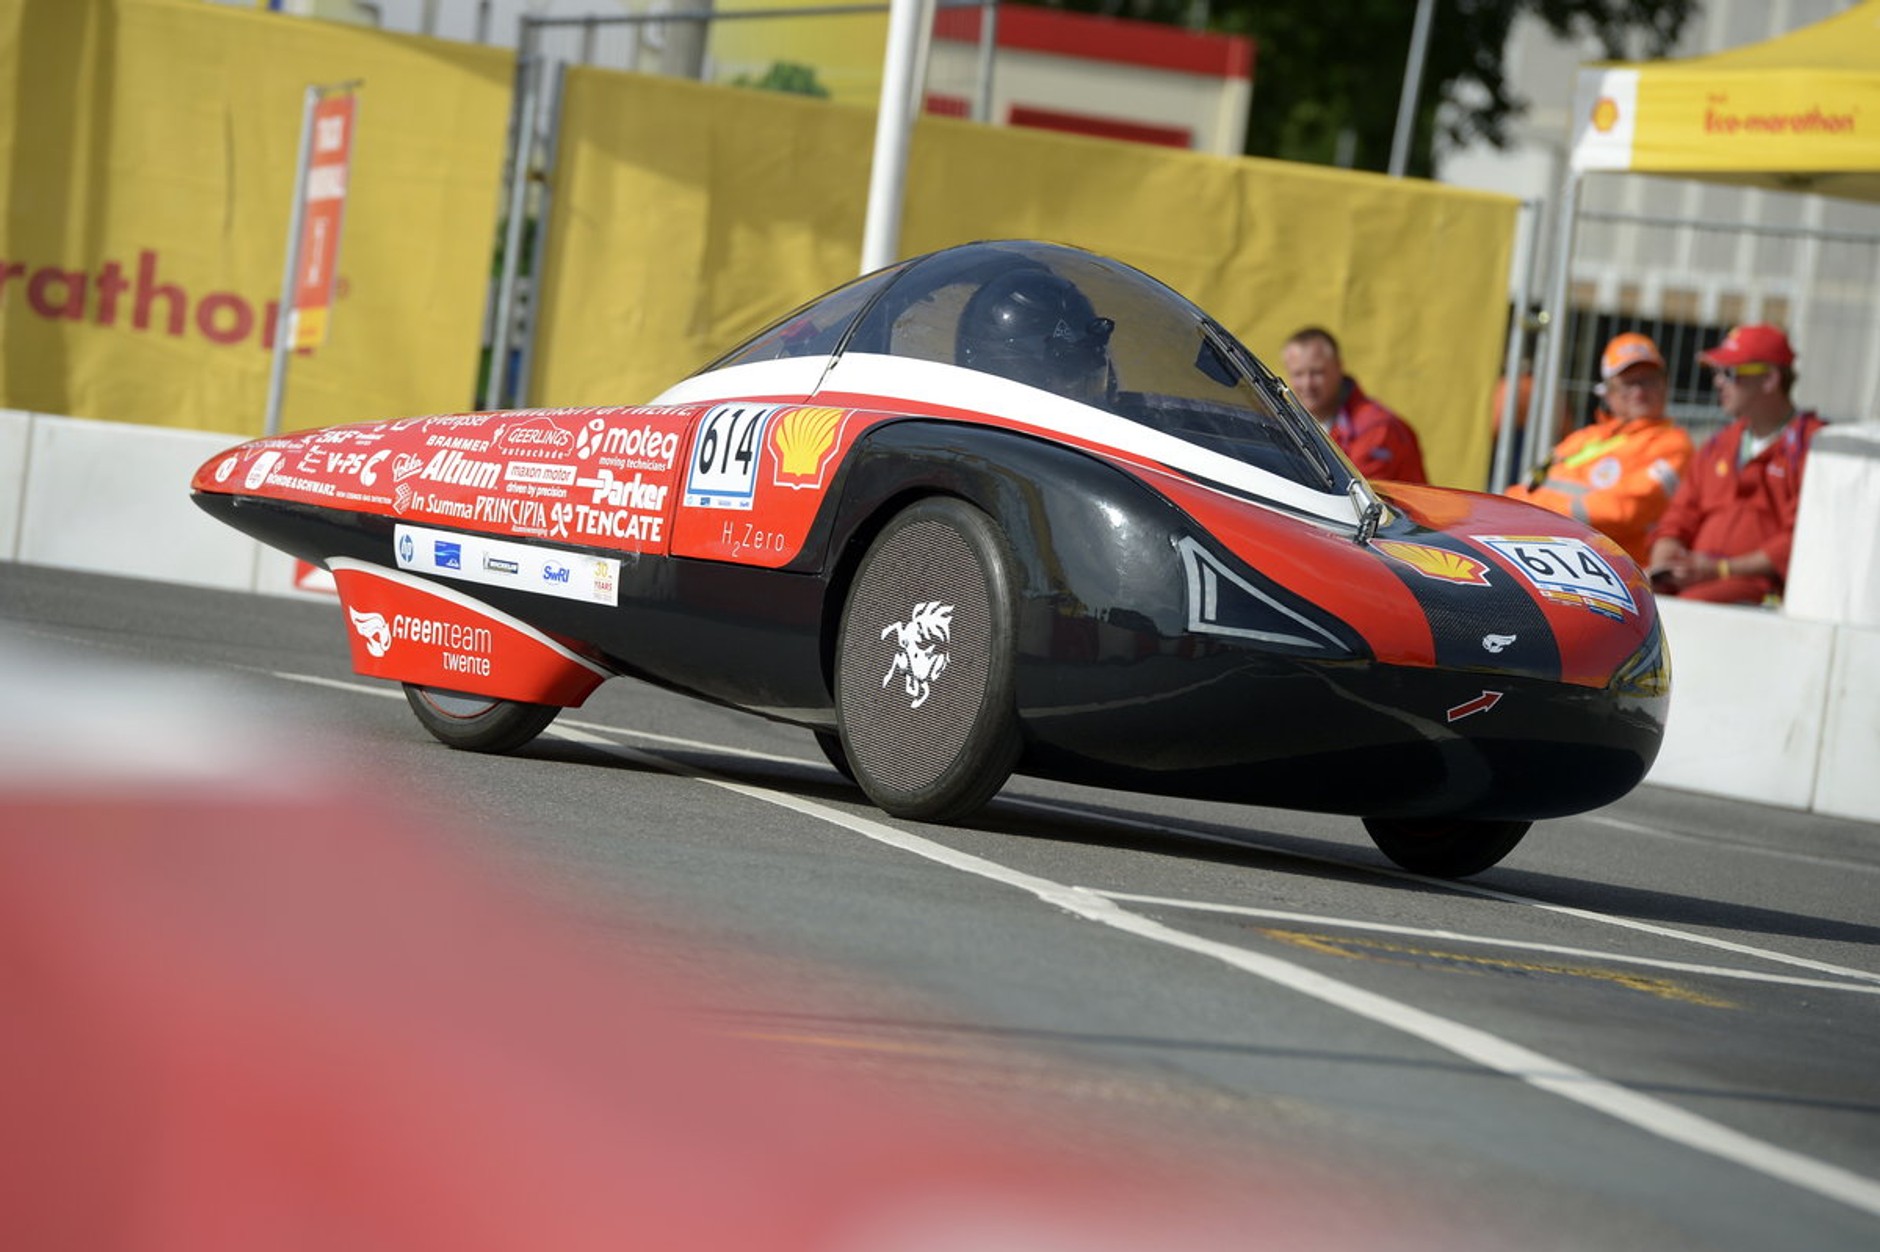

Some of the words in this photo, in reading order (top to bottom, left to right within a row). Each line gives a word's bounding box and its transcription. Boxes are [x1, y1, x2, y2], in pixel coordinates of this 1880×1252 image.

[425, 434, 491, 453] BRAMMER
[507, 427, 569, 447] GEERLINGS
[602, 424, 680, 470] moteq
[698, 407, 768, 476] 614
[501, 447, 565, 460] autoschade
[598, 456, 626, 470] moving
[626, 458, 667, 472] technicians
[419, 448, 502, 489] Altium
[510, 465, 541, 478] maxon
[544, 468, 571, 482] motor
[505, 482, 527, 494] driven
[528, 484, 536, 498] by
[536, 486, 568, 498] precision
[592, 468, 669, 512] Parker
[410, 490, 425, 512] In
[425, 493, 473, 520] Summa
[474, 494, 548, 528] PRINCIPIA
[543, 565, 570, 584] SwRI
[1513, 547, 1614, 587] 614
